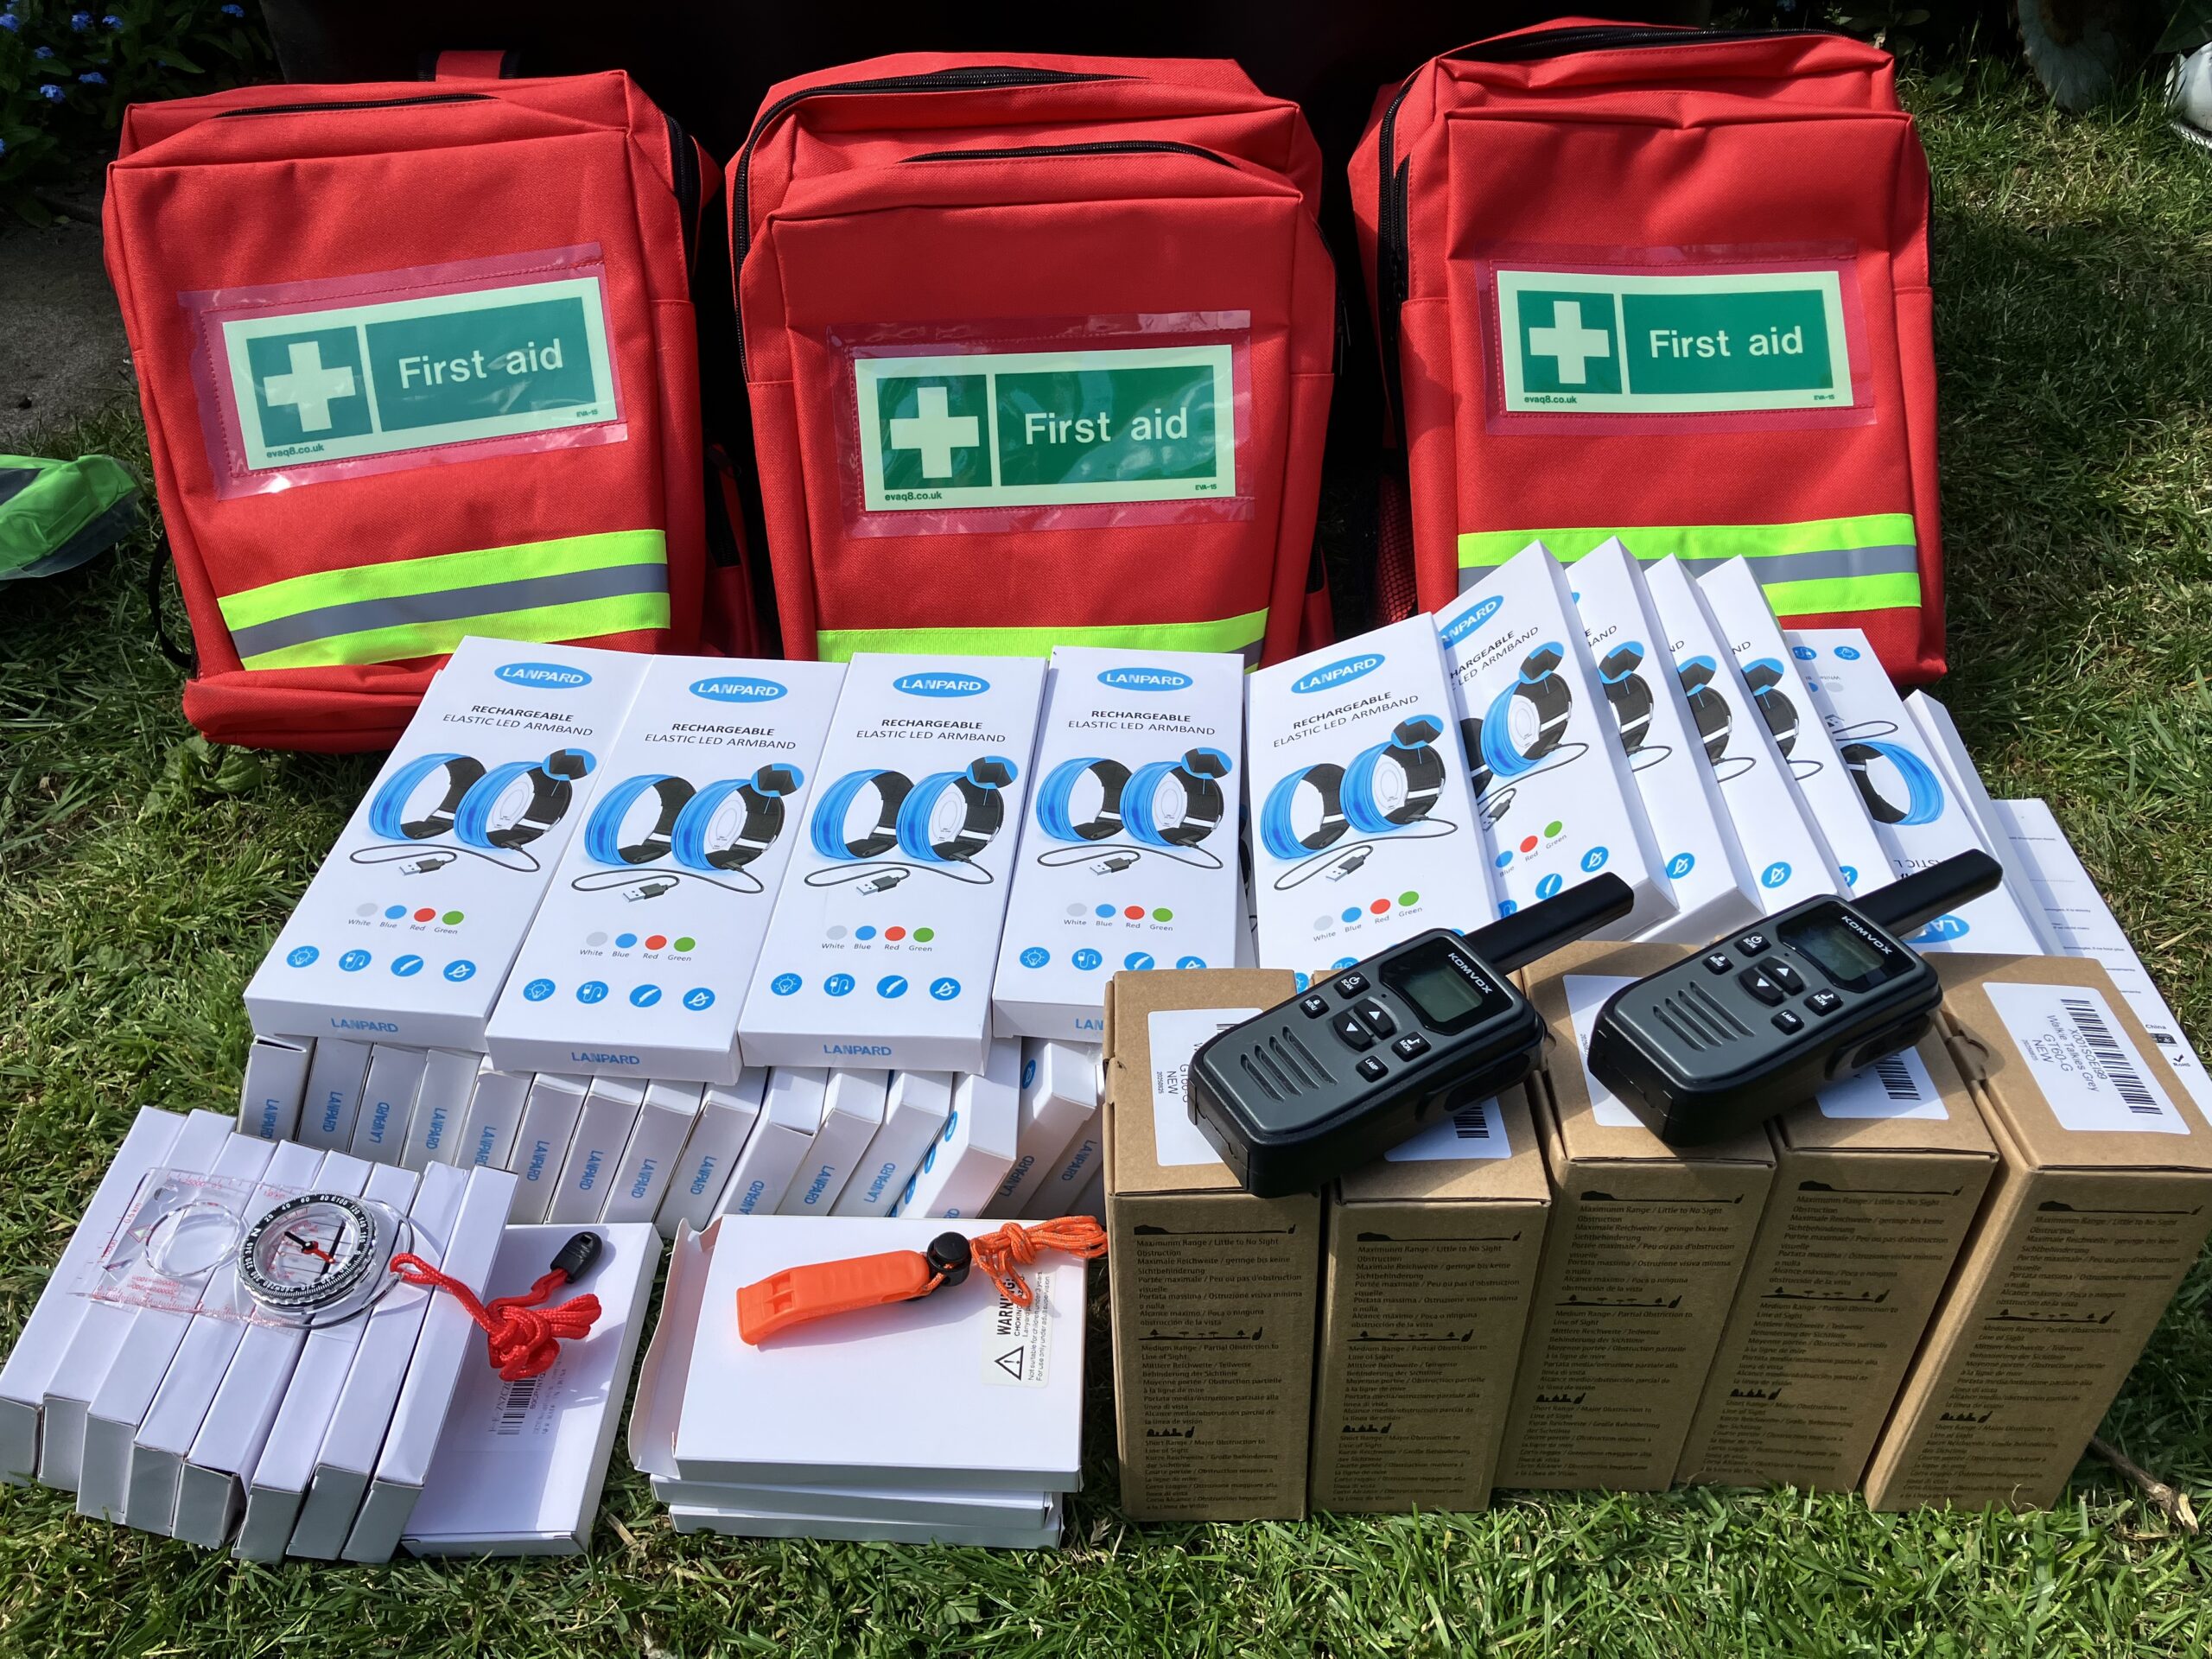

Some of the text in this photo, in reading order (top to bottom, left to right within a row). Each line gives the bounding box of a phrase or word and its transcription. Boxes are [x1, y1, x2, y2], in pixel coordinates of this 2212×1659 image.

[1649, 326, 1803, 359] First aid
[398, 338, 563, 389] First aid
[1523, 395, 1577, 405] evaq8.co.uk
[1025, 407, 1188, 445] First aid
[266, 443, 324, 459] evaq8.co.uk
[884, 490, 943, 502] evaq8.co.uk
[1441, 601, 1497, 640] ANPARD
[1450, 630, 1515, 678] HARGEABLE
[1481, 626, 1539, 670] ARMBAND
[502, 667, 584, 684] LANPARD
[901, 679, 982, 691] LANPARD
[1106, 673, 1185, 686] LANPARD
[1300, 658, 1377, 690] LANPARD
[697, 683, 779, 696] LANPARD
[471, 704, 574, 722] RECHARGEABLE
[1091, 710, 1192, 722] RECHARGEABLE
[1274, 695, 1419, 747] ELASTIC LED ARMBAND
[1293, 691, 1392, 730] RECHARGEABLE
[442, 714, 594, 736] ELASTIC LED ARMBAND
[671, 722, 775, 736] RECHARGEABLE
[881, 719, 983, 729] RECHARGEABLE
[1068, 720, 1117, 729] ELASTIC
[1148, 723, 1216, 735] ARMBAND
[645, 734, 796, 750] ELASTIC LED ARMBAND
[856, 730, 1006, 742] ELASTIC LED ARMBAND
[1500, 835, 1567, 878] Blue Red Green
[434, 926, 458, 935] Green
[1313, 931, 1336, 942] White
[1344, 925, 1362, 933] Blue
[1398, 907, 1423, 918] Green
[1841, 915, 1893, 955] KOMVOX
[1341, 978, 1355, 990] SCAN
[1447, 952, 1493, 995] KOMVOX
[330, 1018, 399, 1033] LANPARD
[823, 1044, 892, 1057] LANPARD
[1399, 1039, 1413, 1052] MON
[2031, 1039, 2055, 1063] NEW
[570, 1051, 641, 1066] LANPARD
[1365, 1058, 1380, 1071] LAMP
[1166, 1071, 1179, 1095] NEW
[2082, 1071, 2100, 1092] Grey
[322, 1090, 344, 1133] LANPARD
[369, 1102, 390, 1144] LANPARD
[426, 1107, 448, 1149] LANPARD
[526, 1140, 550, 1182] LANPARD
[579, 1149, 604, 1191] LANPARD
[1061, 1139, 1098, 1181] LANPARD
[631, 1158, 658, 1199] LANPARD
[690, 1155, 717, 1196] LANPARD
[804, 1165, 836, 1205] LANPARD
[863, 1162, 896, 1204] LANPARD
[999, 1154, 1035, 1198] LANPARD
[335, 1197, 347, 1206] 100
[739, 1179, 765, 1215] ANPARD
[264, 1213, 275, 1223] 20
[349, 1205, 359, 1215] 120
[251, 1228, 262, 1237] N
[358, 1217, 366, 1227] 140
[1182, 1239, 1207, 1248] Range
[1028, 1344, 1037, 1368] suitable
